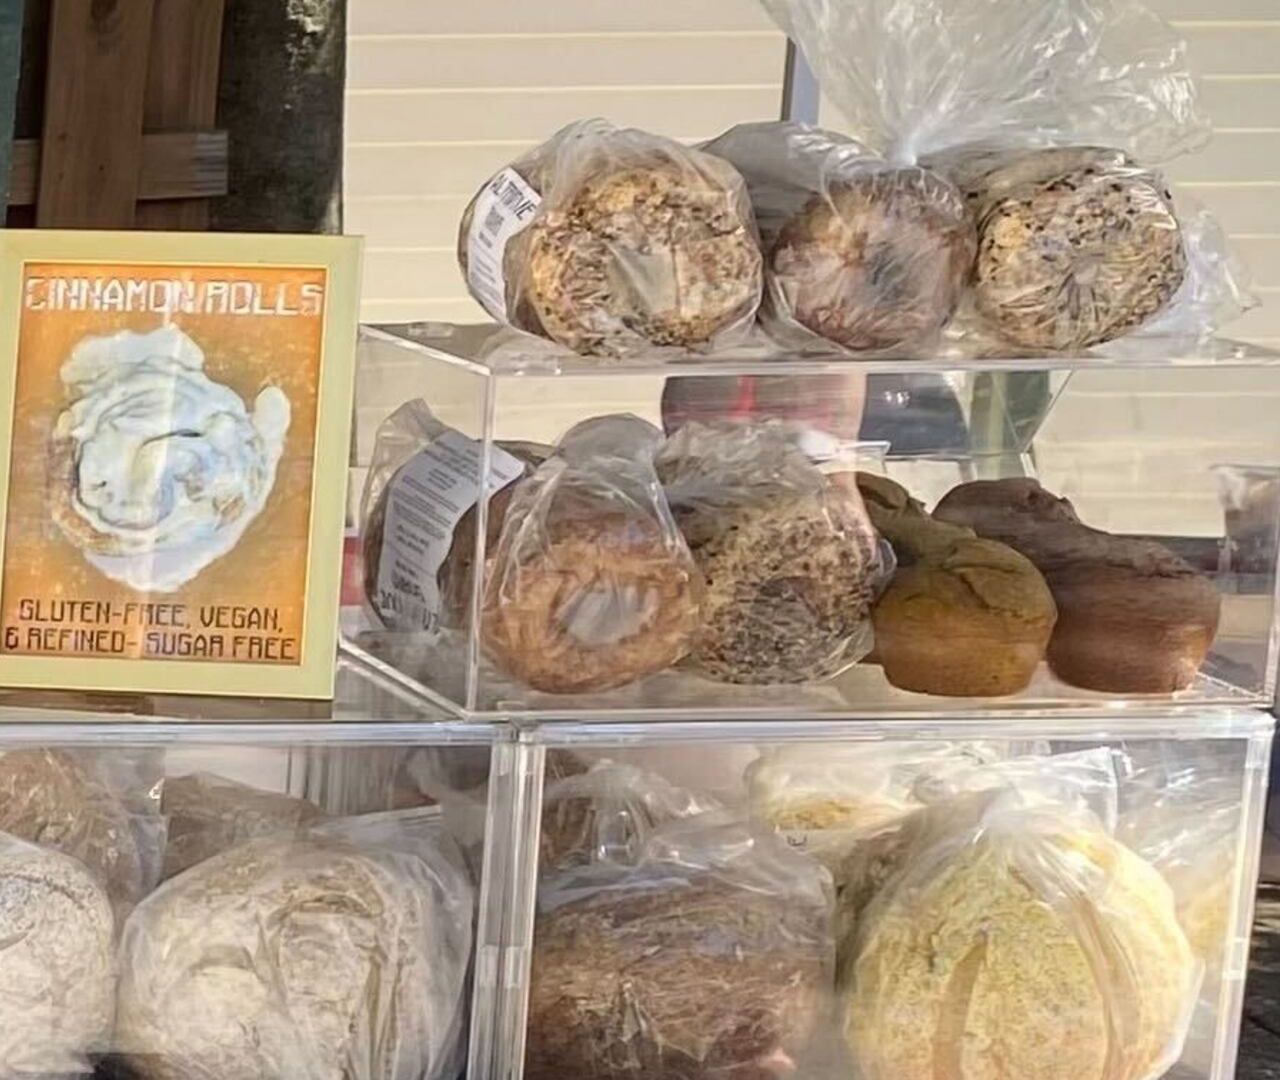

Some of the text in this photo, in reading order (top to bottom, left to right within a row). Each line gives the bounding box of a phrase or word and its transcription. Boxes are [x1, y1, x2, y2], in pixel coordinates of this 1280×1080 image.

[25, 277, 324, 317] CINNAMON ROLLS
[146, 632, 224, 657] SUGAR
[232, 635, 296, 660] FREE
